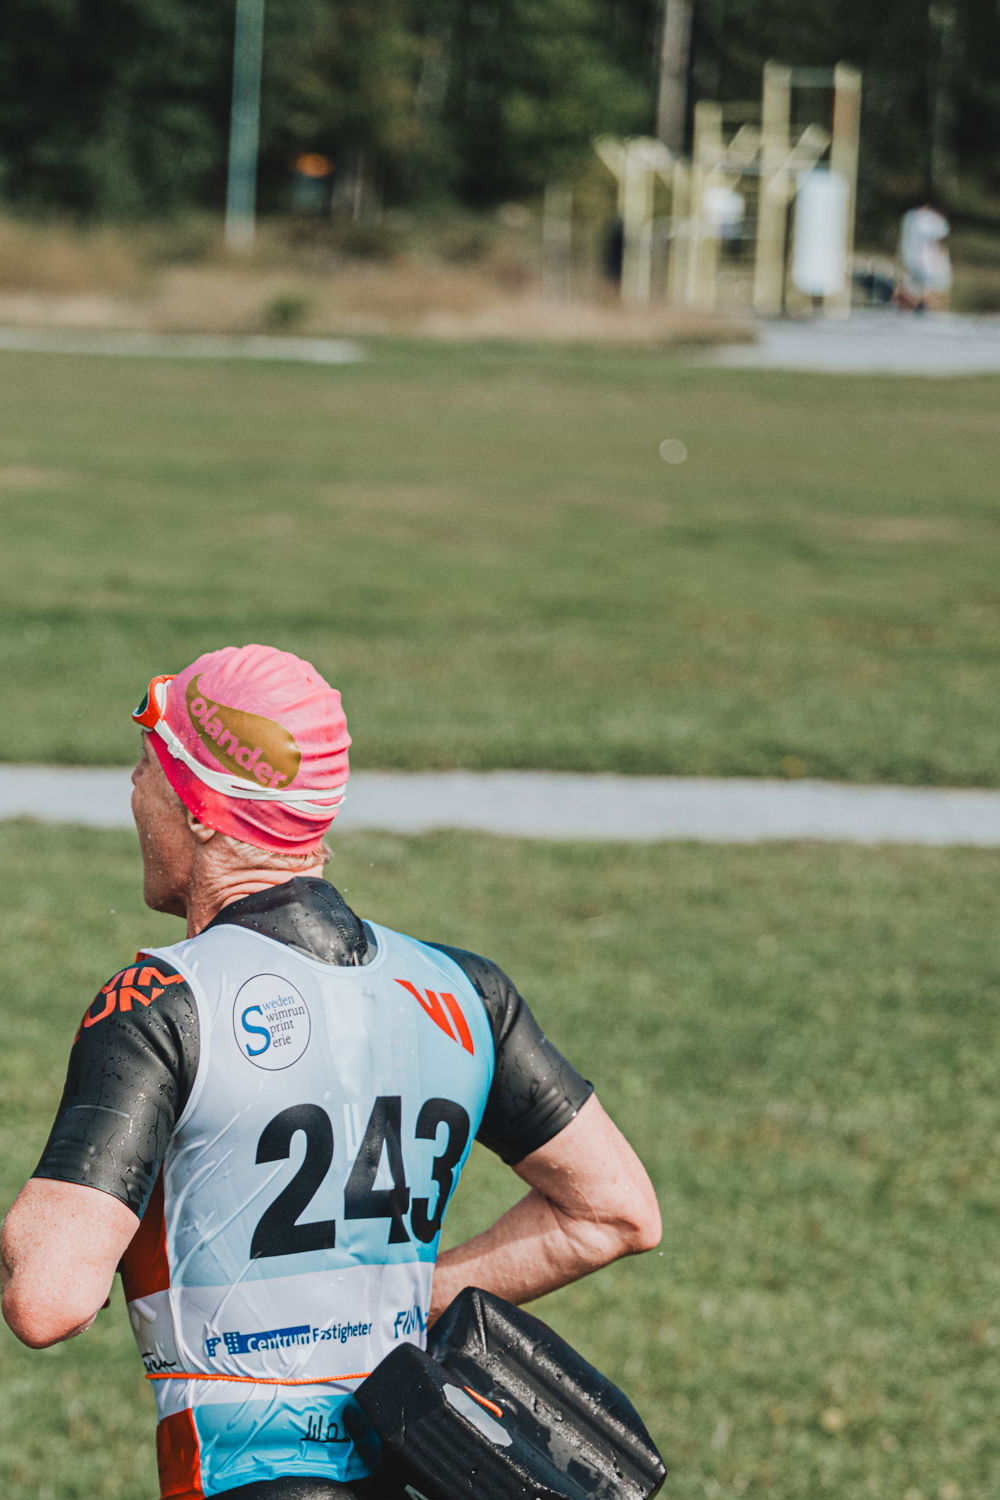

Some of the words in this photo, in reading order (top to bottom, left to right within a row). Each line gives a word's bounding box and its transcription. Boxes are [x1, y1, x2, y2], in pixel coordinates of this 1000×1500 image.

[190, 697, 288, 788] olander
[266, 1006, 306, 1022] wimrun
[270, 1019, 295, 1037] print
[273, 1035, 292, 1048] erie
[250, 1095, 470, 1260] 243
[247, 1332, 311, 1352] Centrum
